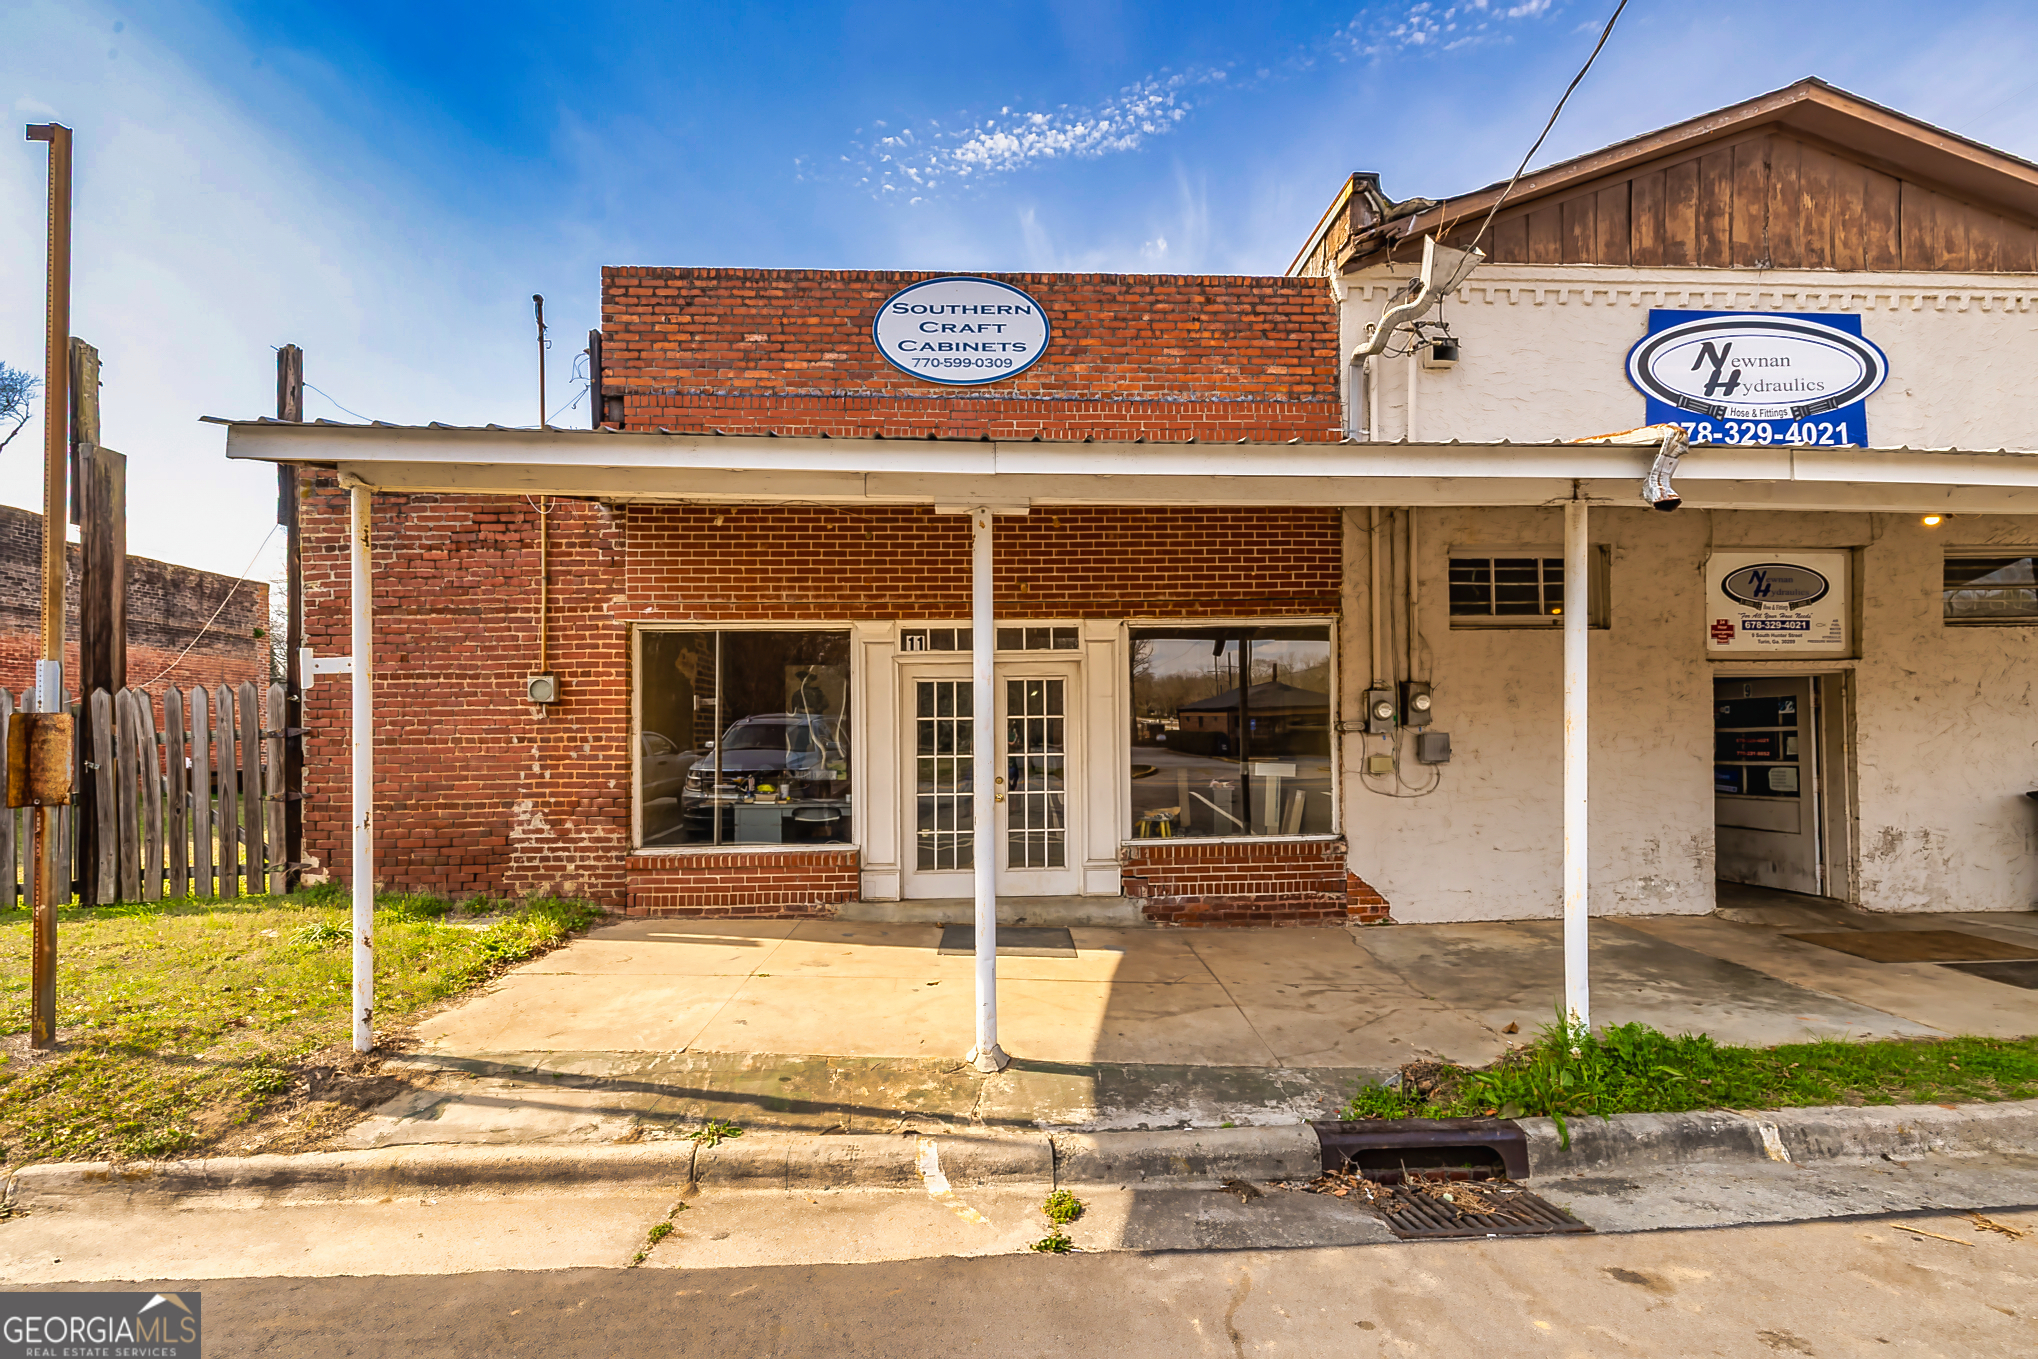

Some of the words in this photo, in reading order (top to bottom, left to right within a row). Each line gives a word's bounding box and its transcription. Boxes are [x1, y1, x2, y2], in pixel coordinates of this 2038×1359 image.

[892, 302, 1031, 315] SOUTHERN
[919, 321, 1007, 334] CRAFT
[897, 340, 1027, 352] CABINETS
[1691, 341, 1791, 371] Newnan
[912, 358, 1012, 368] 770-599-0309
[1703, 369, 1825, 397] Hydraulics
[1730, 407, 1749, 418] Hose
[1751, 408, 1758, 418] &
[1759, 408, 1788, 418] Fittings
[1748, 570, 1794, 585] Newnan
[1753, 583, 1810, 598] Hydraulics
[908, 636, 923, 651] 11
[1745, 685, 1751, 696] 9
